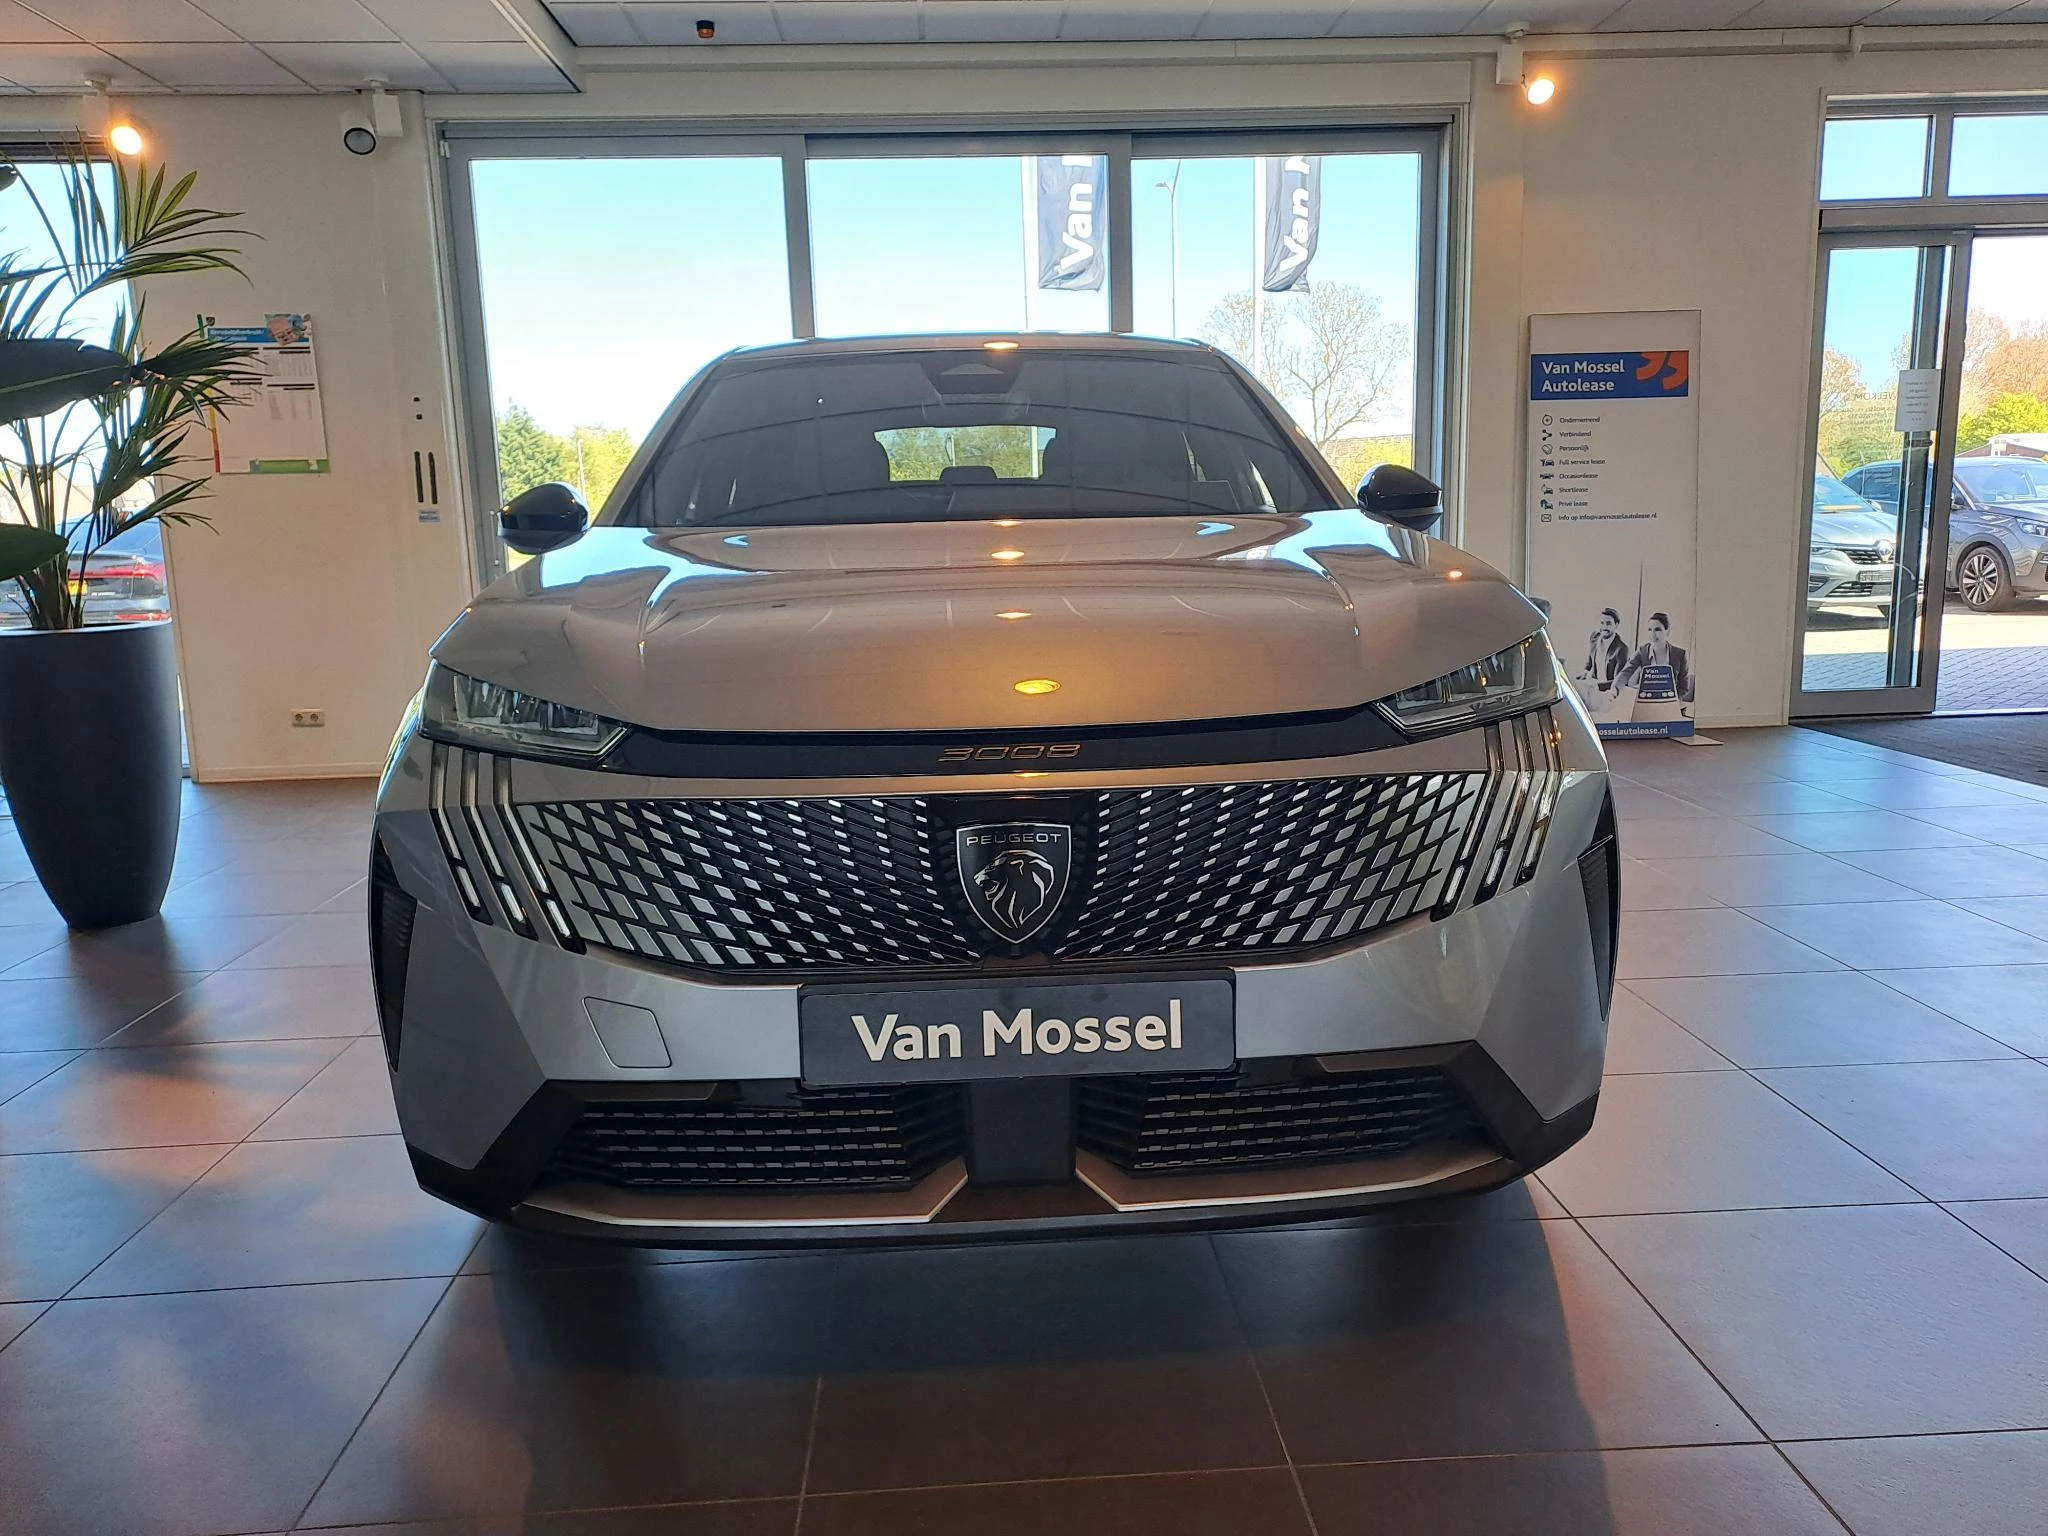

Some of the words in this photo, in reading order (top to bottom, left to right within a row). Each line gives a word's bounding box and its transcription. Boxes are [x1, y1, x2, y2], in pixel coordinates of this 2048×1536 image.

[1060, 183, 1094, 270] Van
[1279, 187, 1309, 272] Van
[1542, 362, 1570, 374] Van
[1574, 359, 1625, 374] Mossel
[1542, 378, 1615, 393] Autolease
[1558, 486, 1589, 494] Shortlease
[1599, 726, 1668, 735] osselautolease.nl
[938, 743, 1081, 762] 3008
[966, 832, 1062, 846] PEUGEOT
[851, 1013, 962, 1063] Van
[982, 998, 1182, 1057] Mossel
